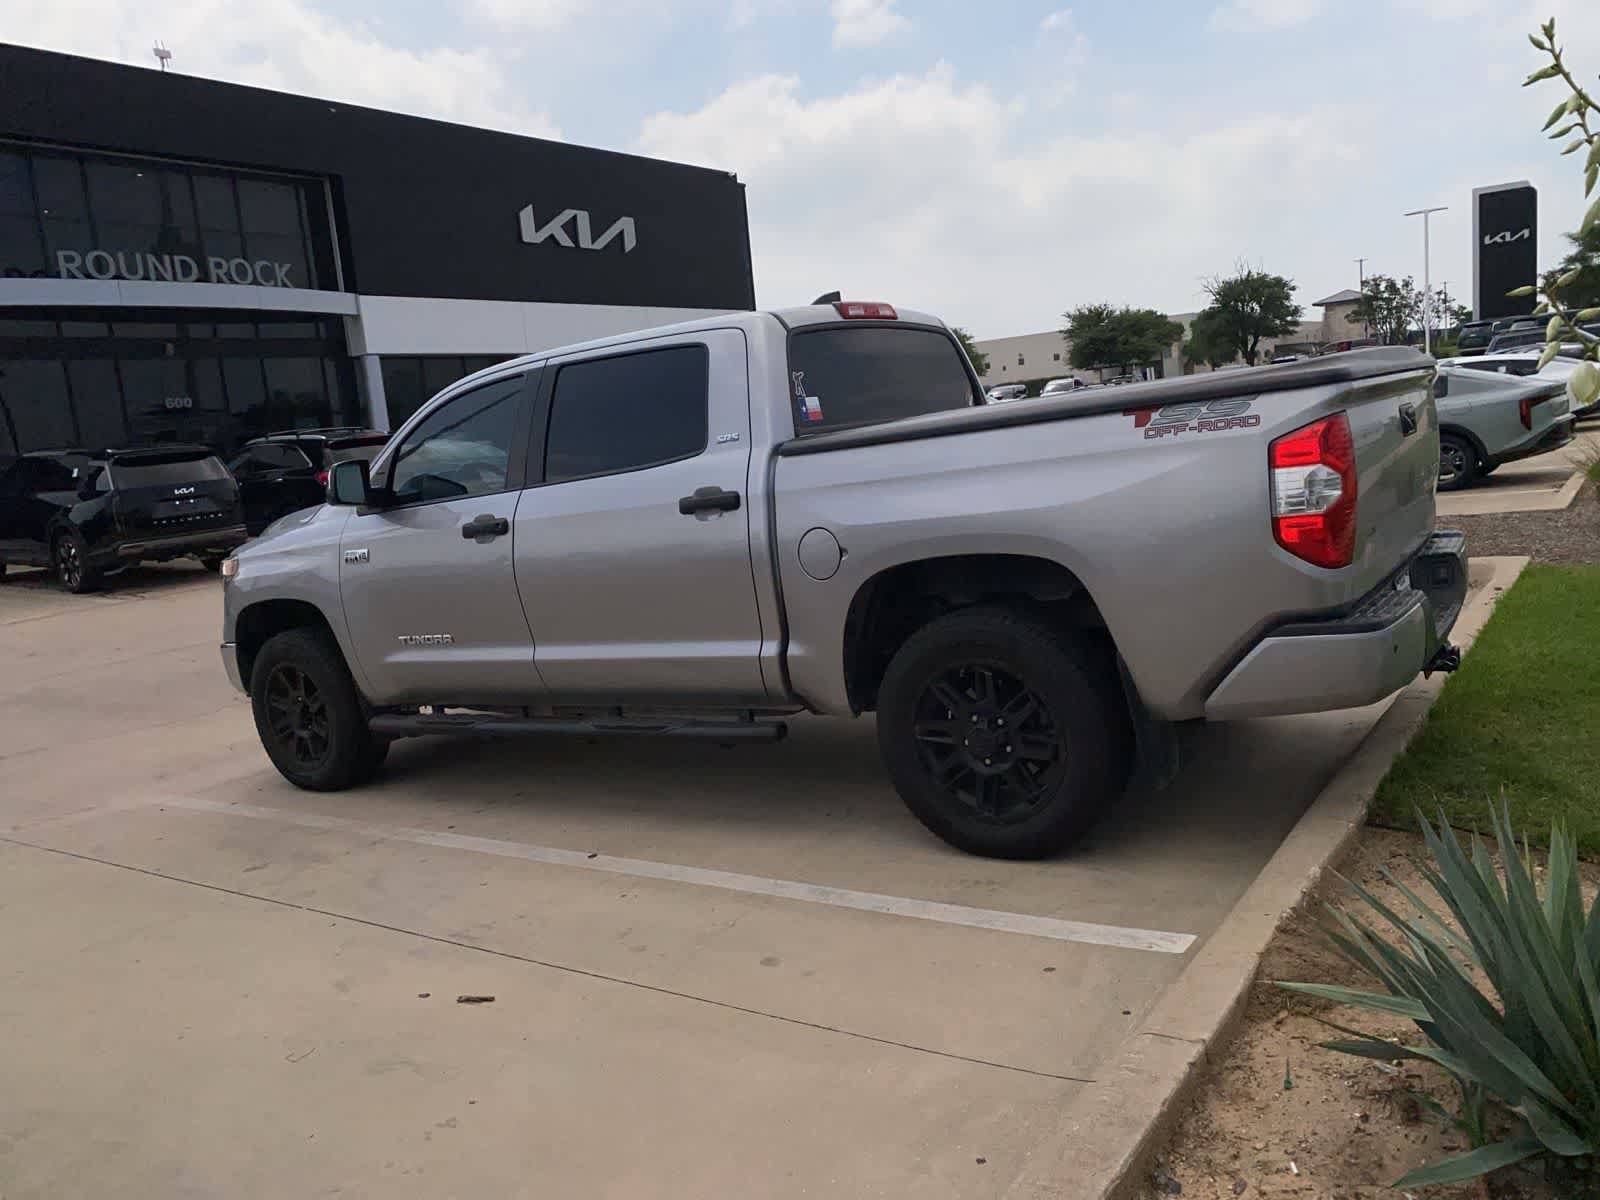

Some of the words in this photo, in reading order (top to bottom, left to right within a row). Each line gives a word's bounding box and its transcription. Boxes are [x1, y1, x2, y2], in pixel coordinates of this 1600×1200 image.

[520, 204, 636, 253] KIA
[1484, 228, 1530, 245] KIA
[56, 250, 200, 282] ROUND
[208, 256, 294, 288] ROCK
[165, 398, 192, 409] 600
[1144, 414, 1261, 440] OFF-ROAD
[174, 487, 194, 495] KIA
[398, 634, 455, 645] TUNDRA
